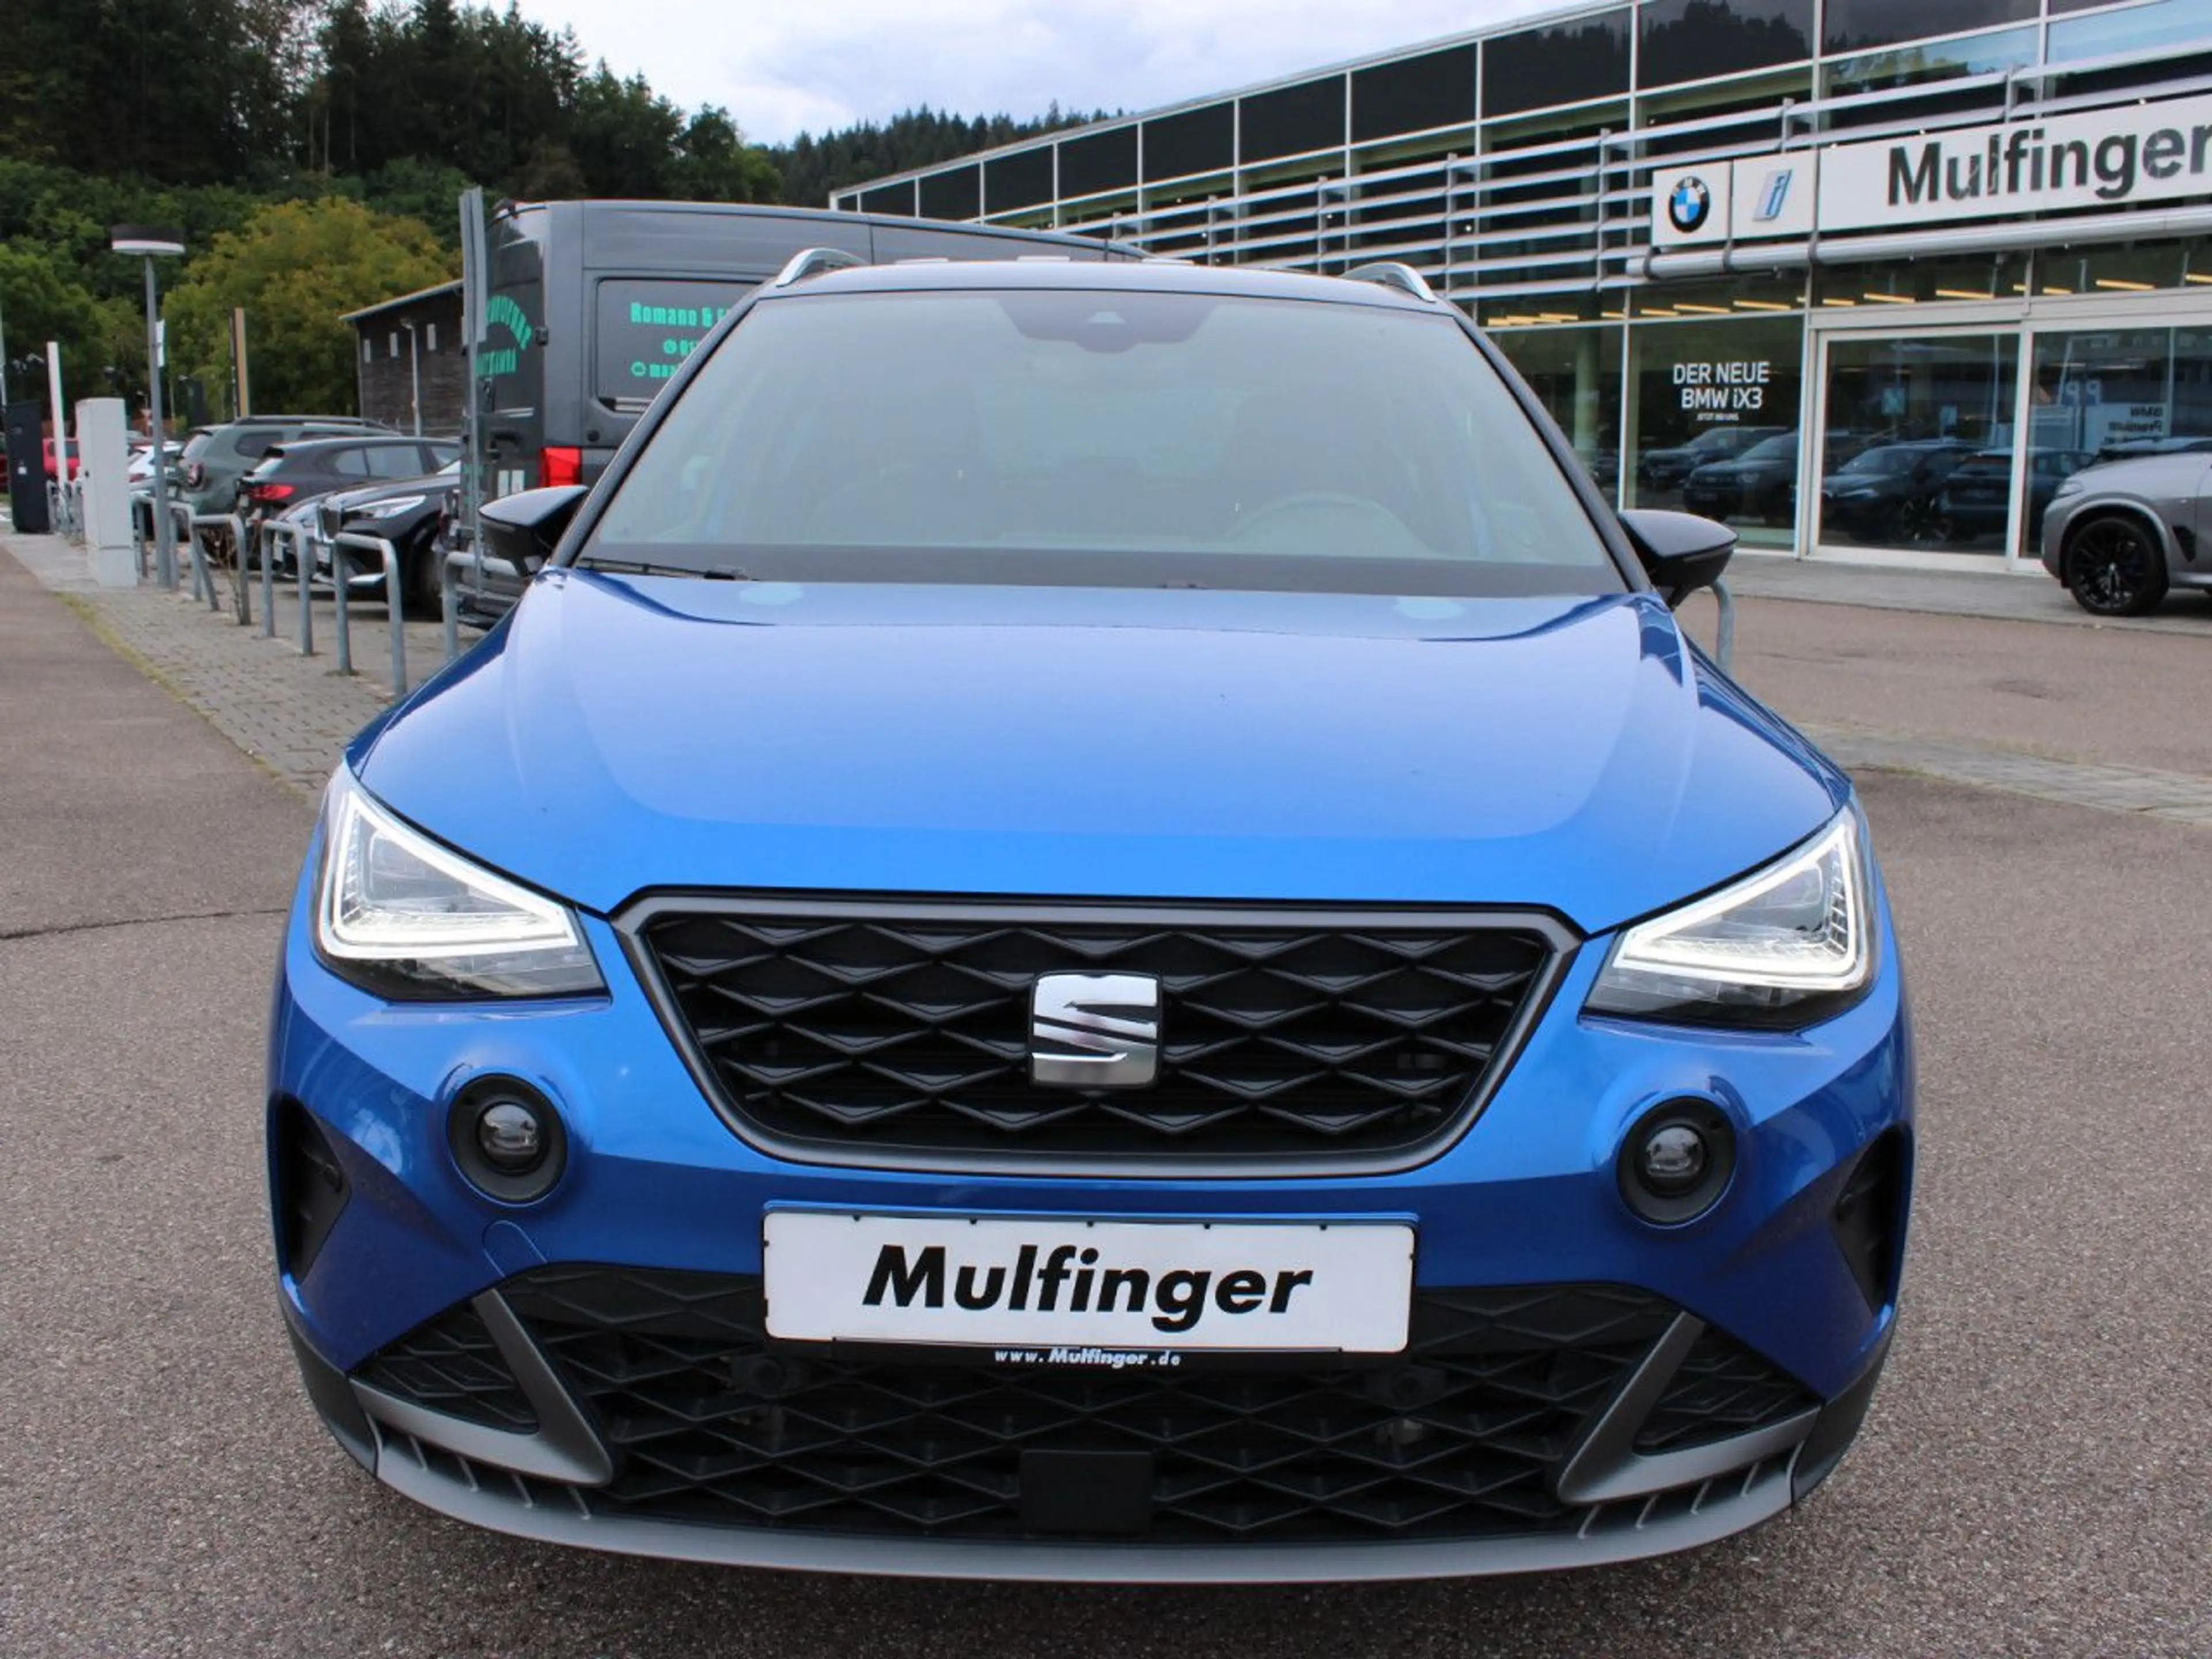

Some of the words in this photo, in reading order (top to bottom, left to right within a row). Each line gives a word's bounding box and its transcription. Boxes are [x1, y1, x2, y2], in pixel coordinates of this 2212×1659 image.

[1888, 123, 2212, 206] Mulfinger
[630, 302, 698, 327] Romano
[1673, 362, 1711, 384] DER
[1715, 361, 1770, 384] NEUE
[1681, 387, 1728, 409] BMW
[1733, 386, 1763, 409] iX3
[862, 1244, 1313, 1334] Mulfinger
